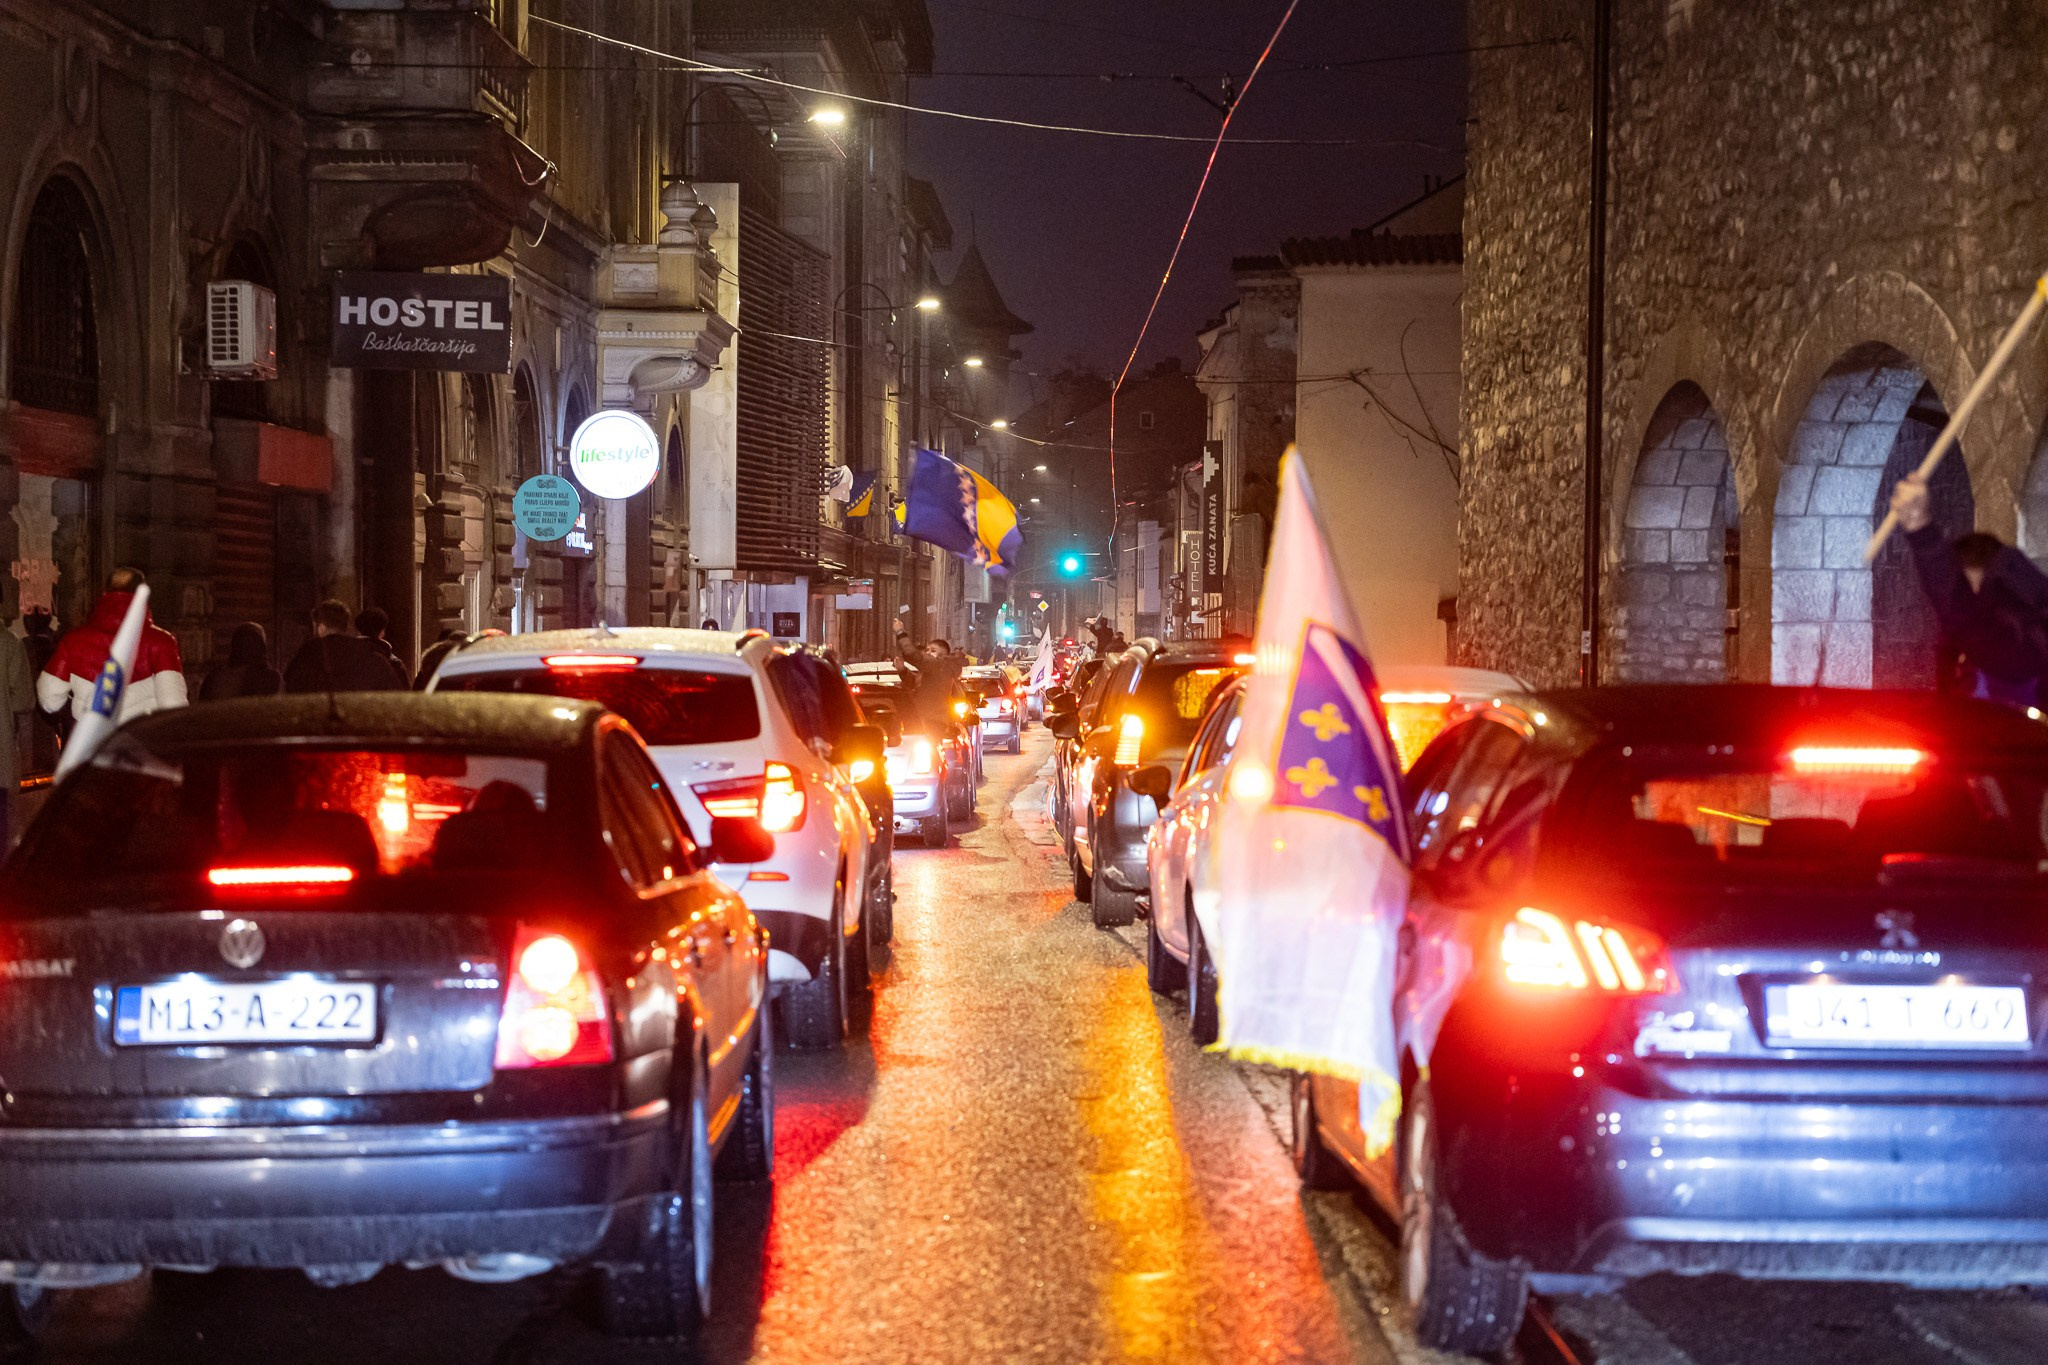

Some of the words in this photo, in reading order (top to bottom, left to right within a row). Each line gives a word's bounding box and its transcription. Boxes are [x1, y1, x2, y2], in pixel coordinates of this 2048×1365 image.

[339, 296, 504, 331] HOSTEL
[362, 331, 477, 360] Bašbaščaršija
[580, 445, 650, 463] lifestyle
[1208, 493, 1218, 541] ZANATA
[1190, 539, 1201, 592] HOTEL
[1207, 542, 1218, 576] KUĆA
[148, 993, 363, 1032] M13-A-222
